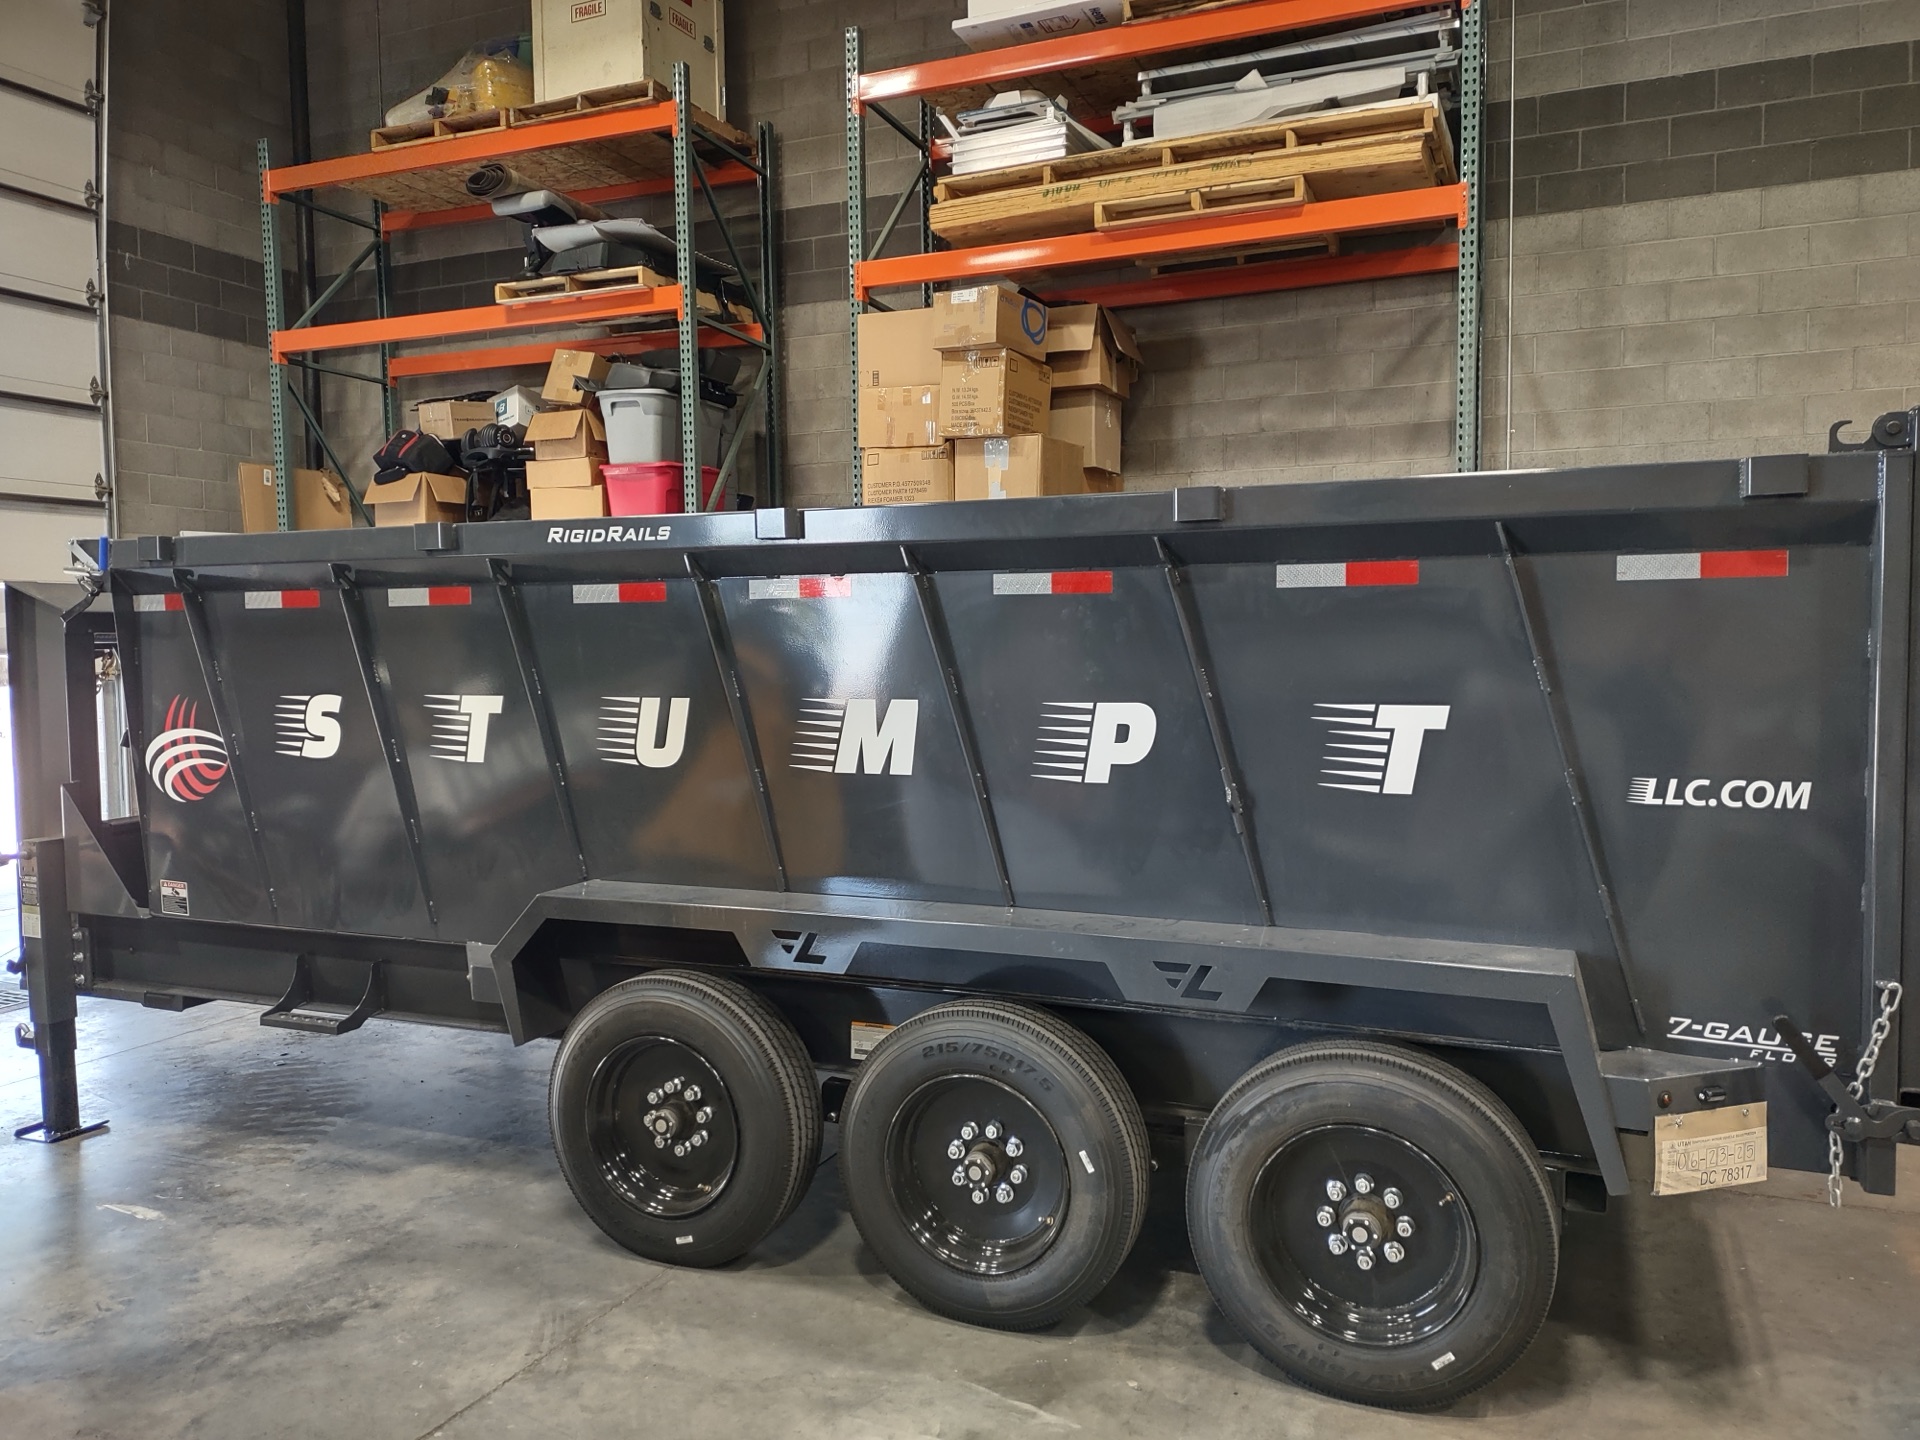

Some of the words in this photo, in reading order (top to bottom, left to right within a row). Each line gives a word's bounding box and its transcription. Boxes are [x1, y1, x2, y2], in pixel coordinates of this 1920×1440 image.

[574, 4, 602, 19] FRAGILE
[671, 12, 693, 35] FRAGILE
[867, 481, 892, 489] CUSTOMER
[1628, 777, 1812, 810] LLC.COM
[1668, 1016, 1840, 1052] 7-GAUE
[1750, 1049, 1837, 1068] FLOR
[1700, 1170, 1717, 1186] DC
[1721, 1165, 1752, 1182] 78317
